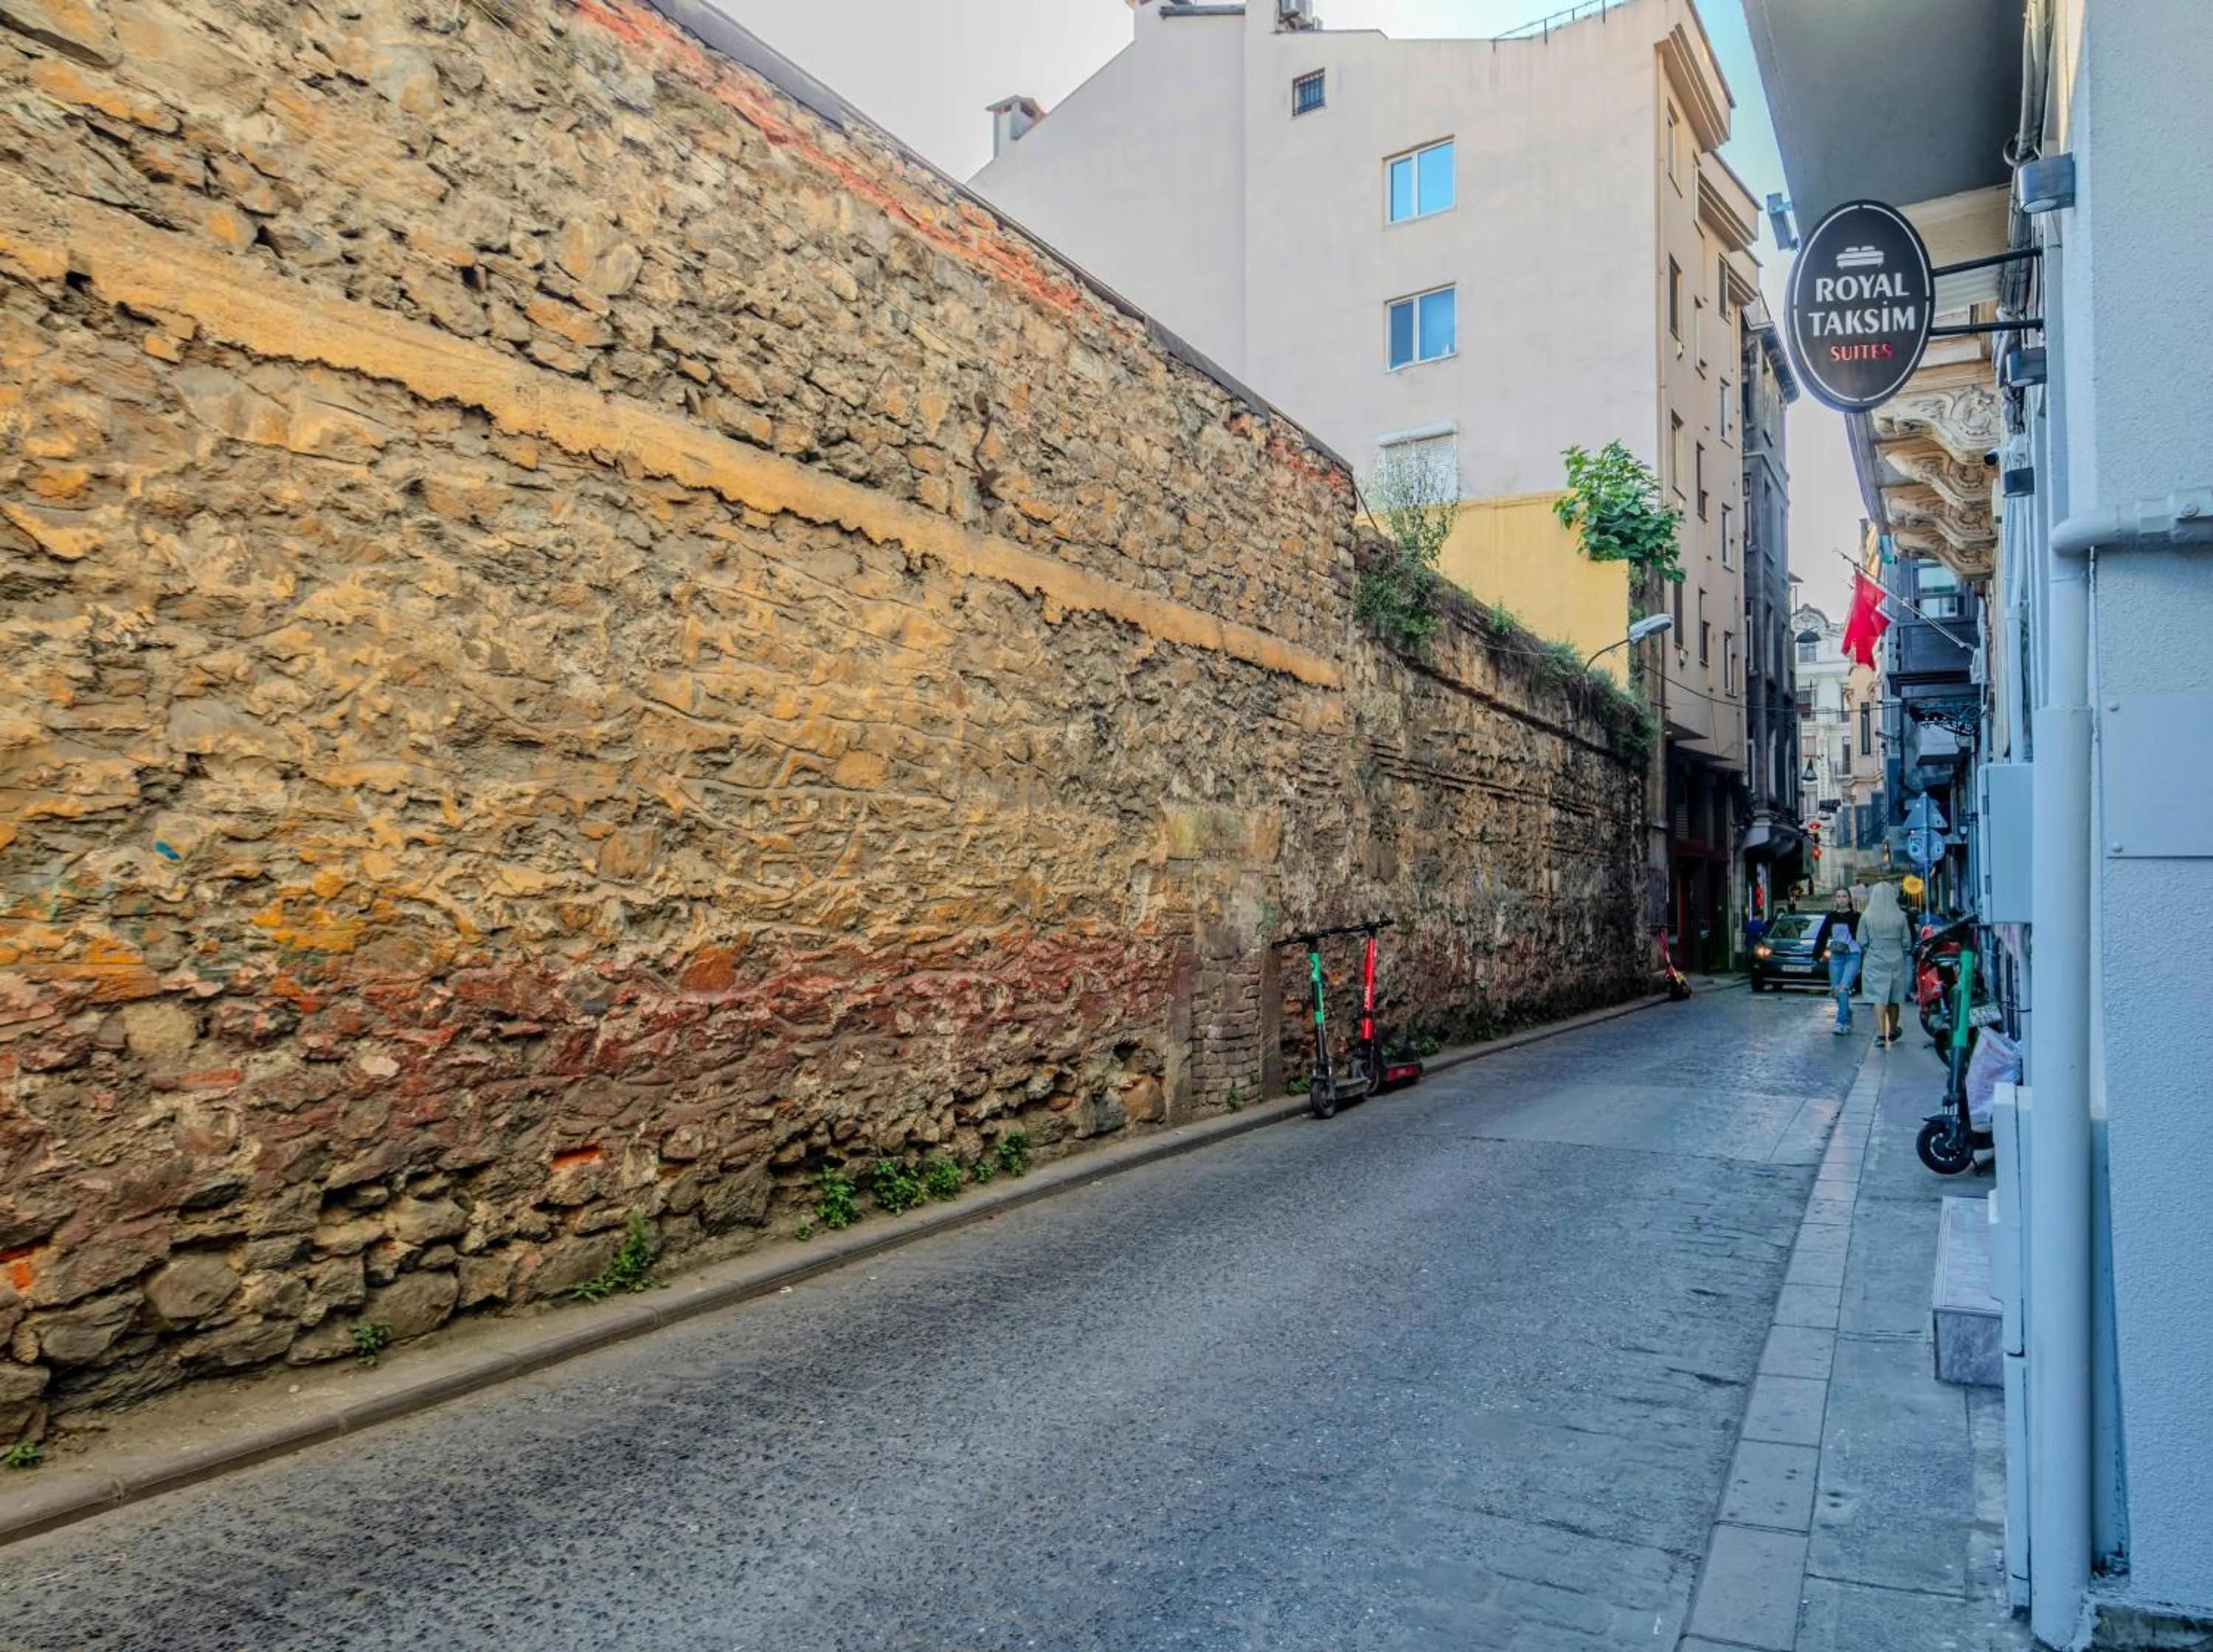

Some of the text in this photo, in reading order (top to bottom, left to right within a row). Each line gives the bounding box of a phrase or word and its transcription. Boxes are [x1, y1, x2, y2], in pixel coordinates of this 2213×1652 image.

[1815, 272, 1910, 302] ROYAL
[1808, 300, 1916, 337] TAKSİM
[1829, 343, 1893, 362] SUITES
